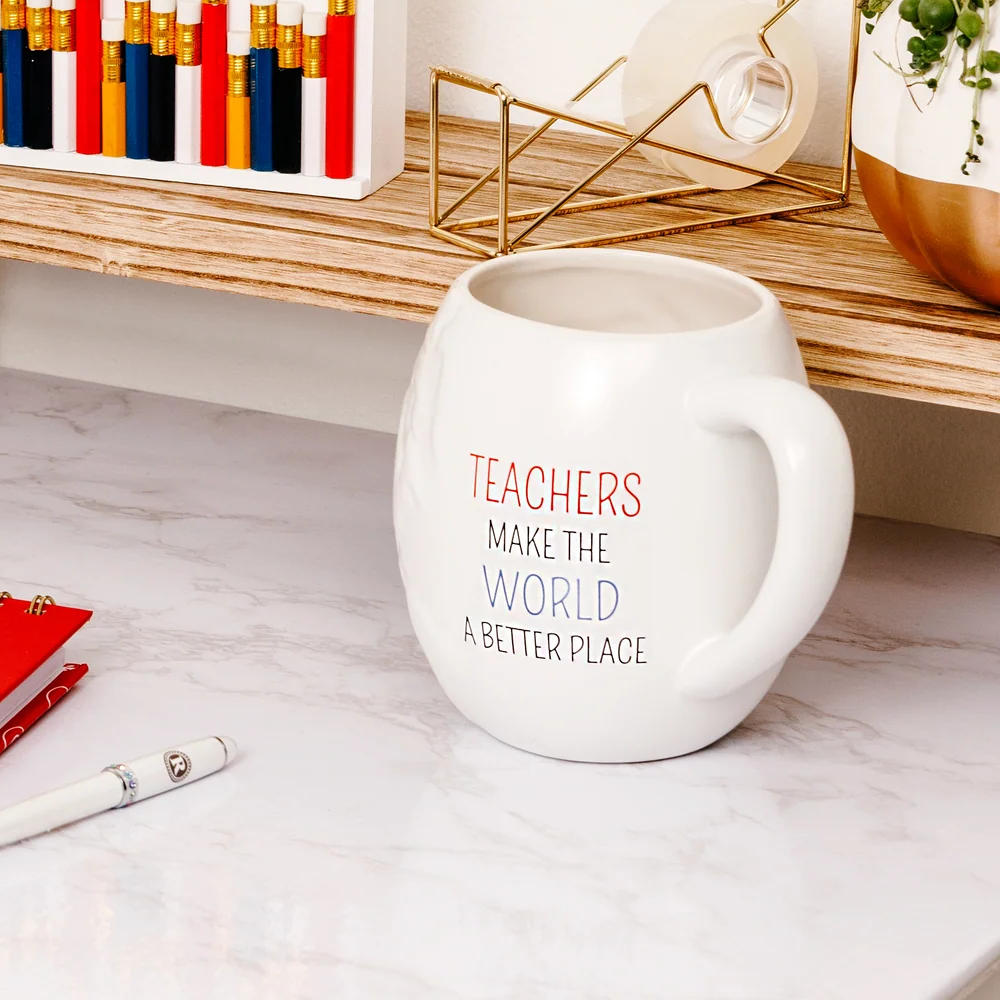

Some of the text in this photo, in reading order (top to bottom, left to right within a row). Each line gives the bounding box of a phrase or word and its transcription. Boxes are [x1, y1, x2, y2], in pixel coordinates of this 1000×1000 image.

[469, 453, 642, 518] TEACHERS
[488, 519, 611, 564] MAKE THE
[482, 564, 620, 621] WORLD
[464, 616, 648, 665] A BETTER PLACE
